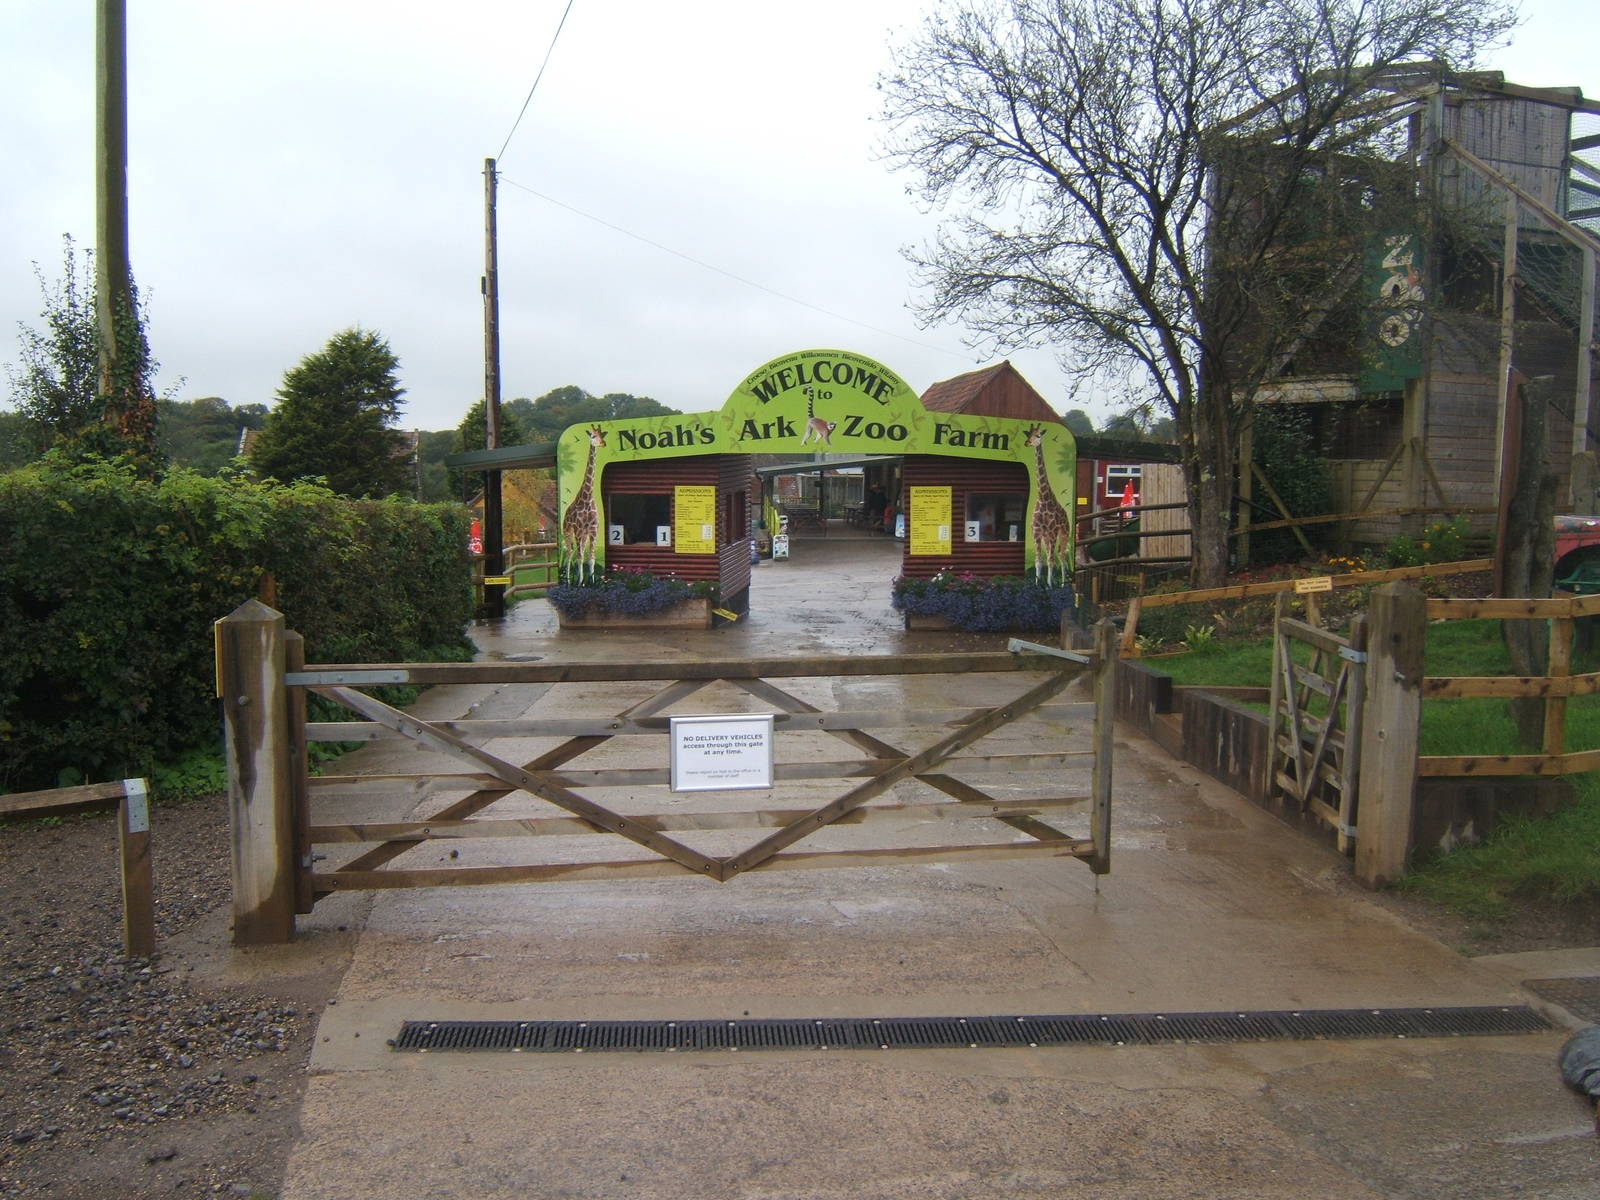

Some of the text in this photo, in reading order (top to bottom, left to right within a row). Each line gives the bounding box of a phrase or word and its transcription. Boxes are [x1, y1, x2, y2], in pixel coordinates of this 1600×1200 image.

[750, 360, 895, 406] WELCOME
[817, 389, 833, 400] to
[618, 414, 1009, 451] Noah's Ark Zoo Farm
[612, 530, 621, 541] 2
[660, 531, 667, 542] 1
[967, 526, 977, 537] 3
